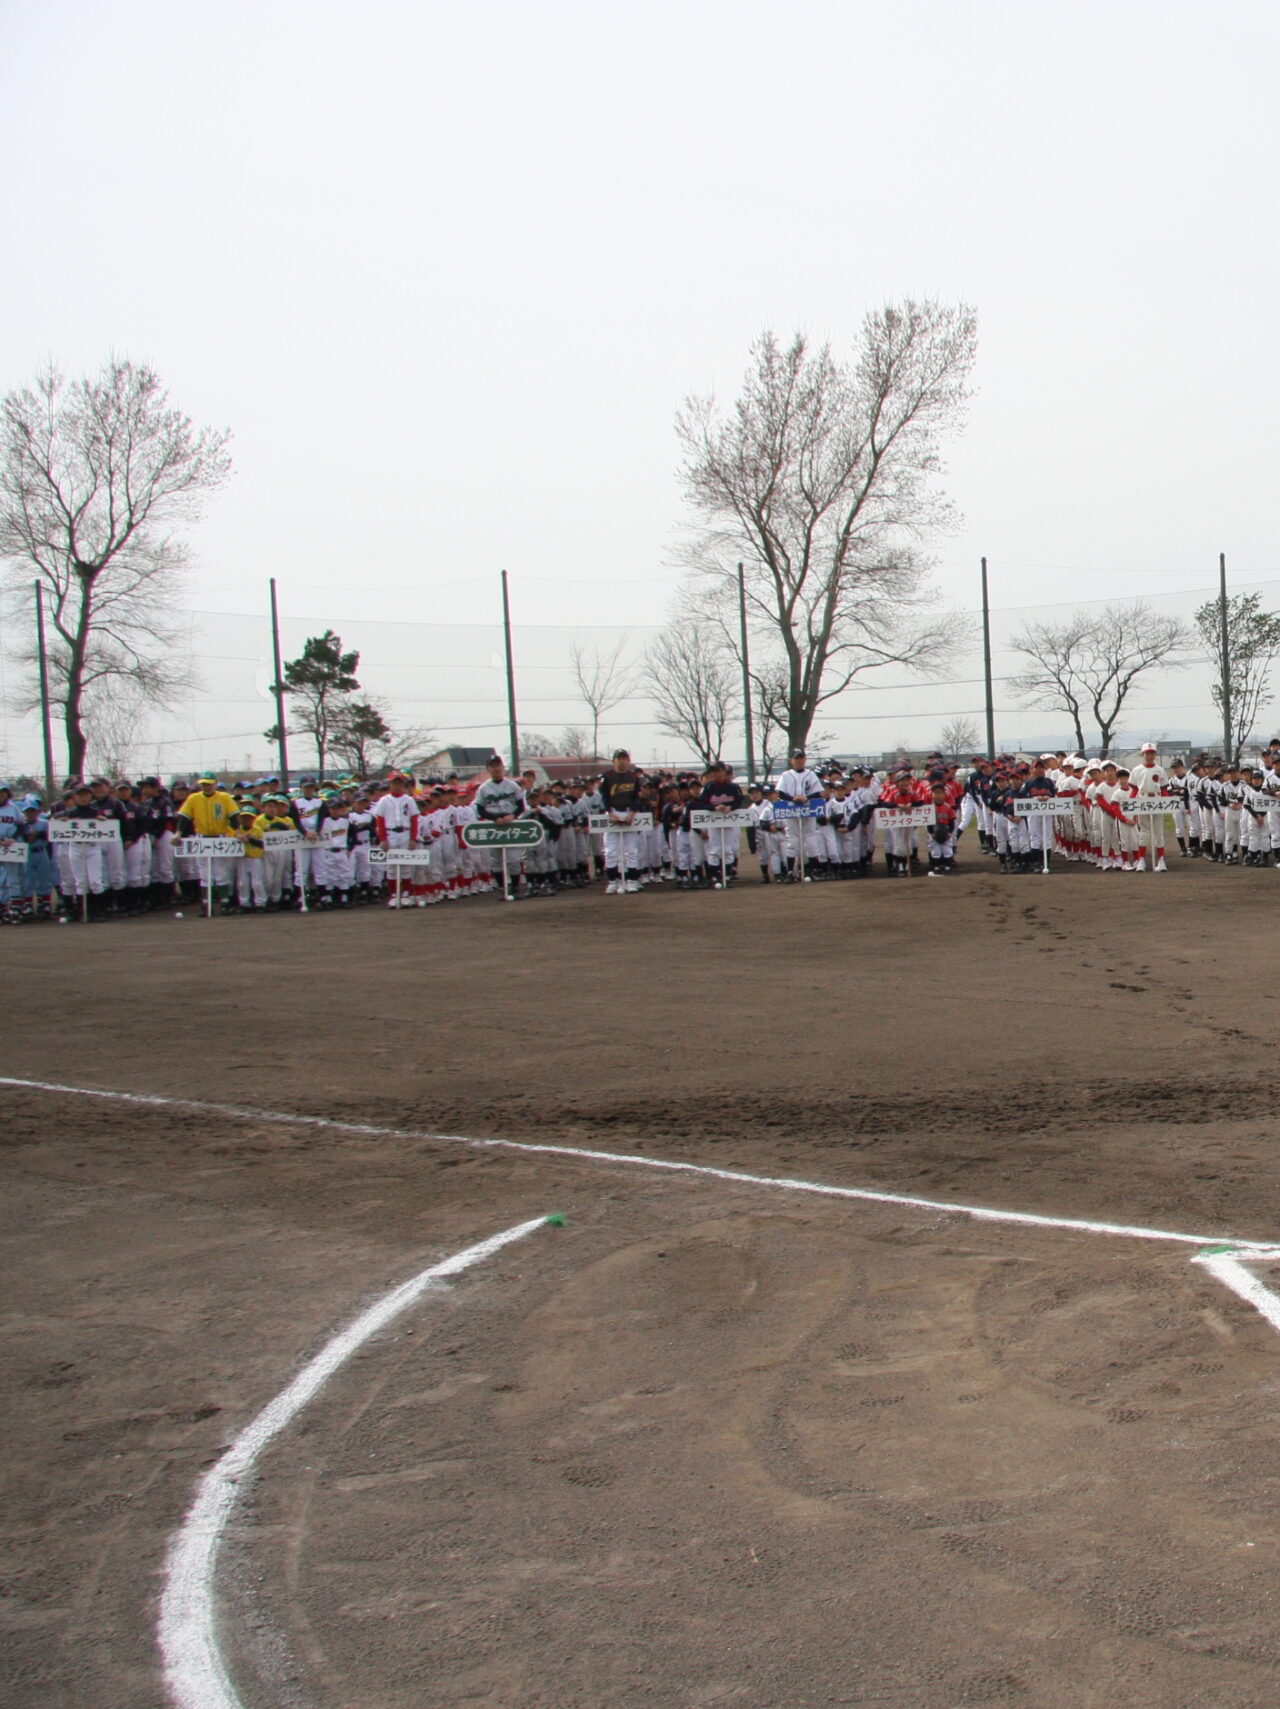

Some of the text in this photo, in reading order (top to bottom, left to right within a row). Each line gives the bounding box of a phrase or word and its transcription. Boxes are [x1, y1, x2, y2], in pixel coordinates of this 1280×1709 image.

[1017, 801, 1072, 812] 鉄東スワローズ
[881, 816, 930, 827] ファイターズ
